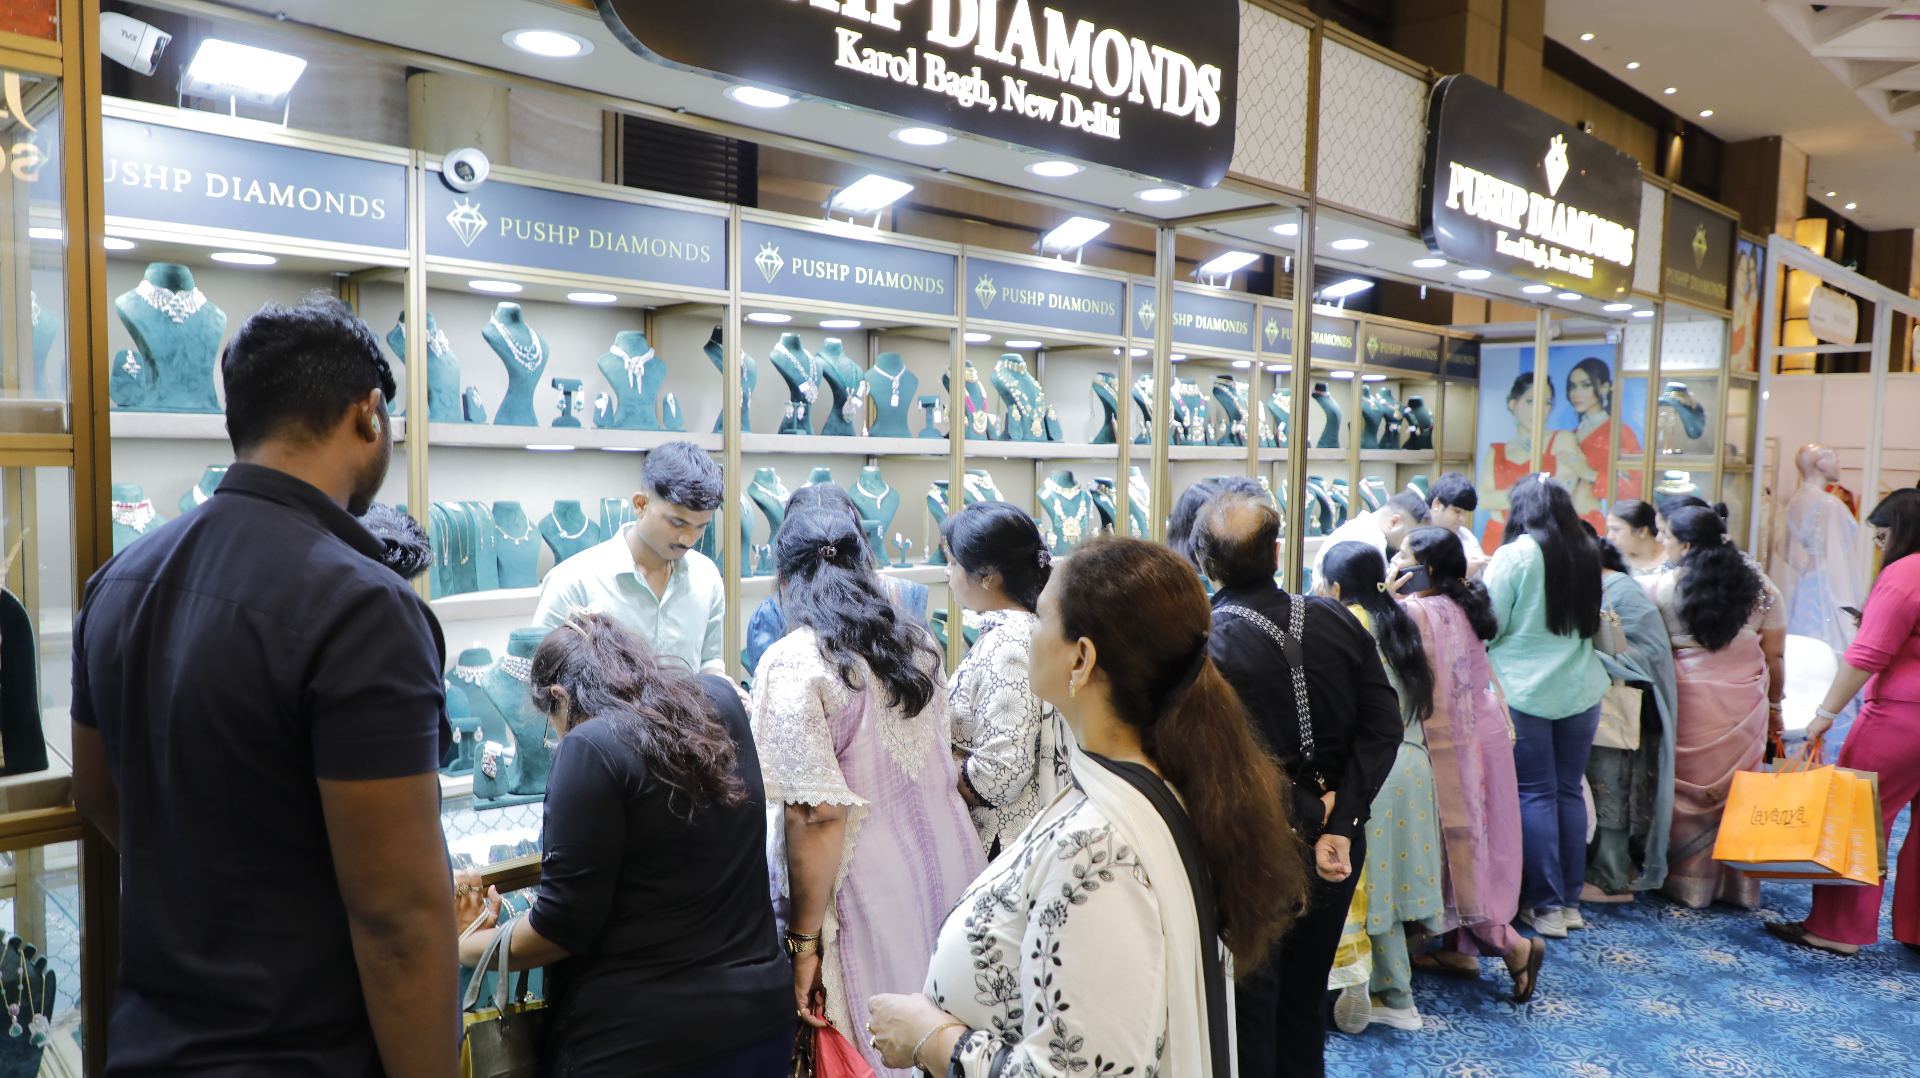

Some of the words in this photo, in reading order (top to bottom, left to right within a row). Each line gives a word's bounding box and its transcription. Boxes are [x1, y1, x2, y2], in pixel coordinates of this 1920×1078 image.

[834, 27, 919, 86] Karol
[924, 53, 997, 112] Bagh,
[1002, 75, 1059, 122] New
[1061, 92, 1121, 139] Delhi
[927, 0, 1221, 127] DIAMONDS
[102, 159, 192, 193] USHP
[205, 172, 386, 220] DIAMONDS
[500, 217, 580, 246] PUSHP
[589, 229, 711, 263] DIAMONDS
[792, 257, 850, 281] PUSHP
[855, 266, 944, 294] DIAMONDS
[1002, 287, 1045, 306] PUSHP
[1048, 293, 1116, 316] DIAMONDS
[1172, 312, 1194, 328] SHP
[1195, 315, 1249, 335] DIAMONDS
